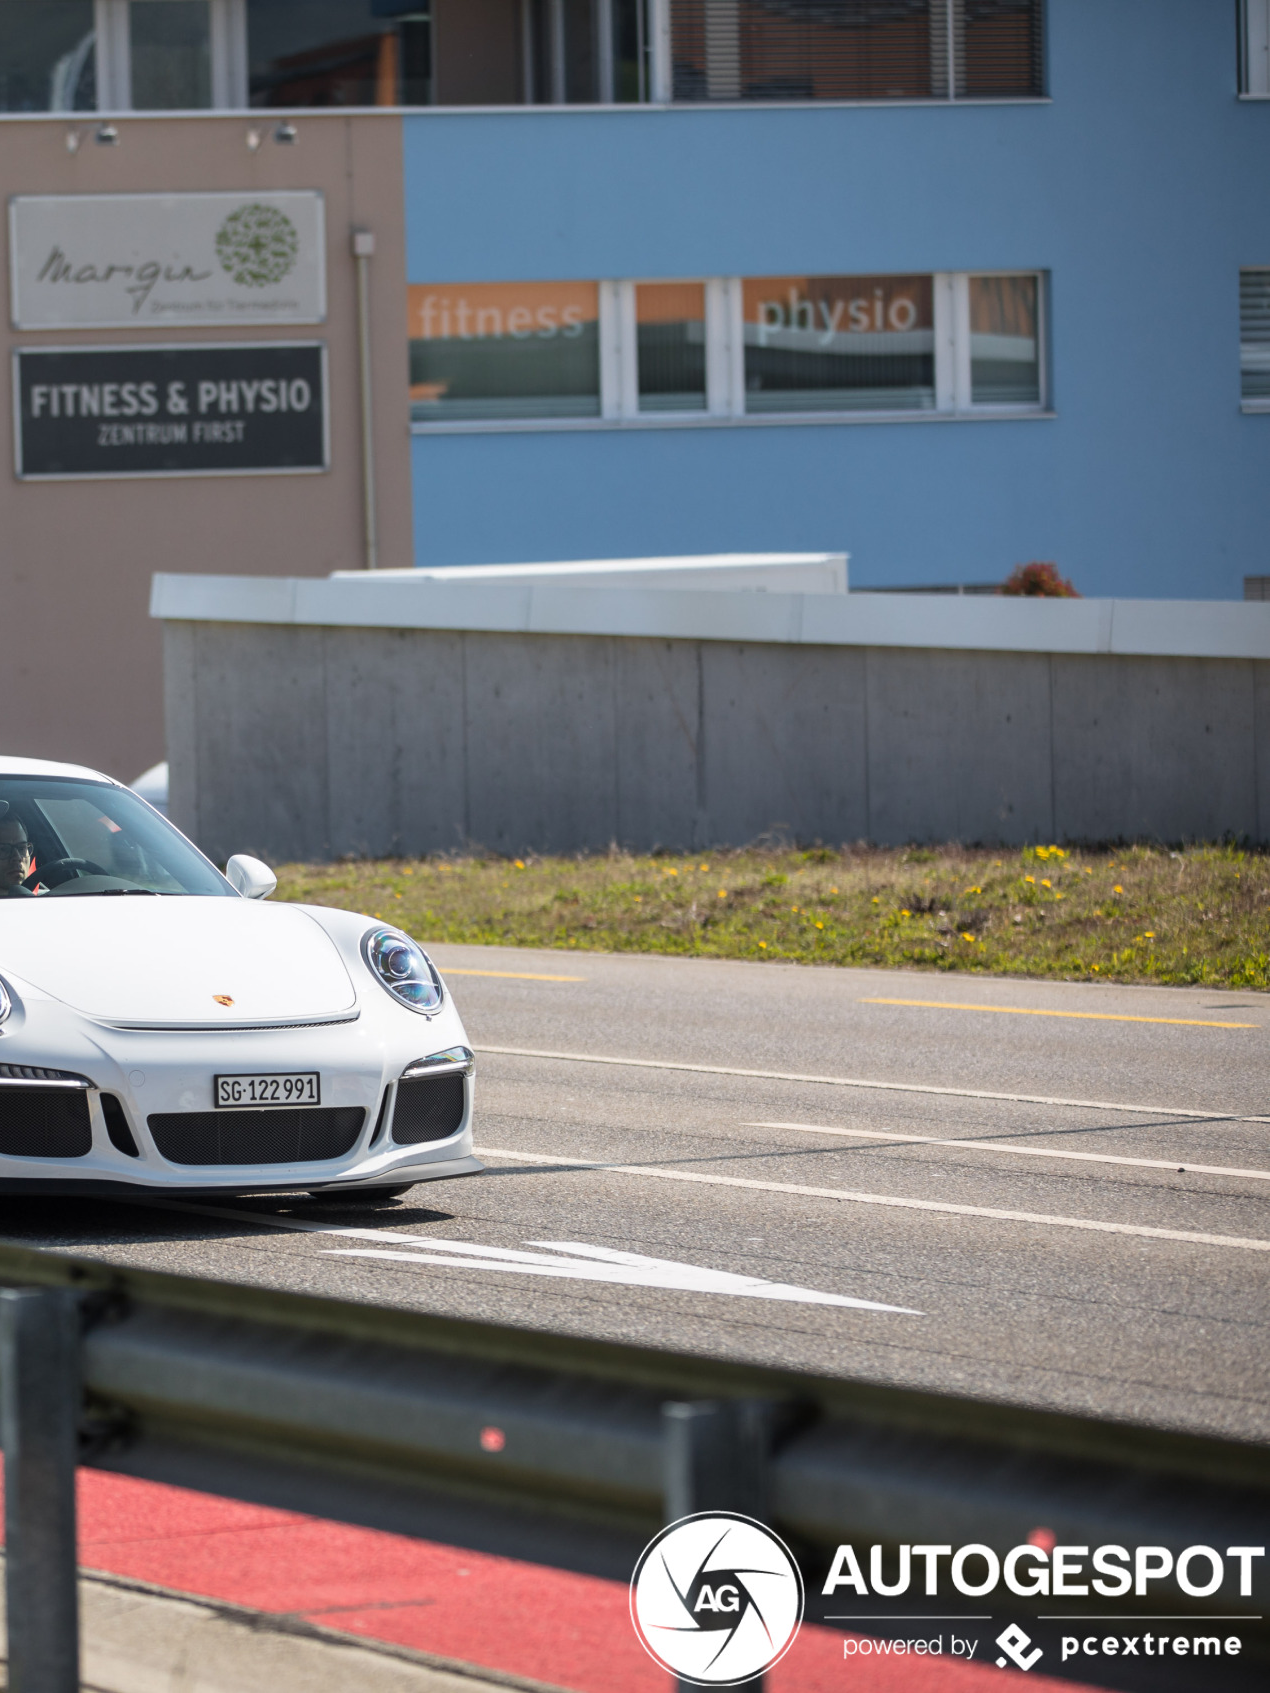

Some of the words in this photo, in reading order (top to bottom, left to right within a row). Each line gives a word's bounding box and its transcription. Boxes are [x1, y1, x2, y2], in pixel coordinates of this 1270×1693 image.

[420, 295, 584, 340] fitness
[757, 286, 918, 346] physio
[31, 382, 159, 418] FITNESS
[167, 381, 190, 415] &
[198, 378, 311, 414] PHYSIO
[97, 423, 189, 446] ZENTRUM
[193, 421, 246, 443] FIRST
